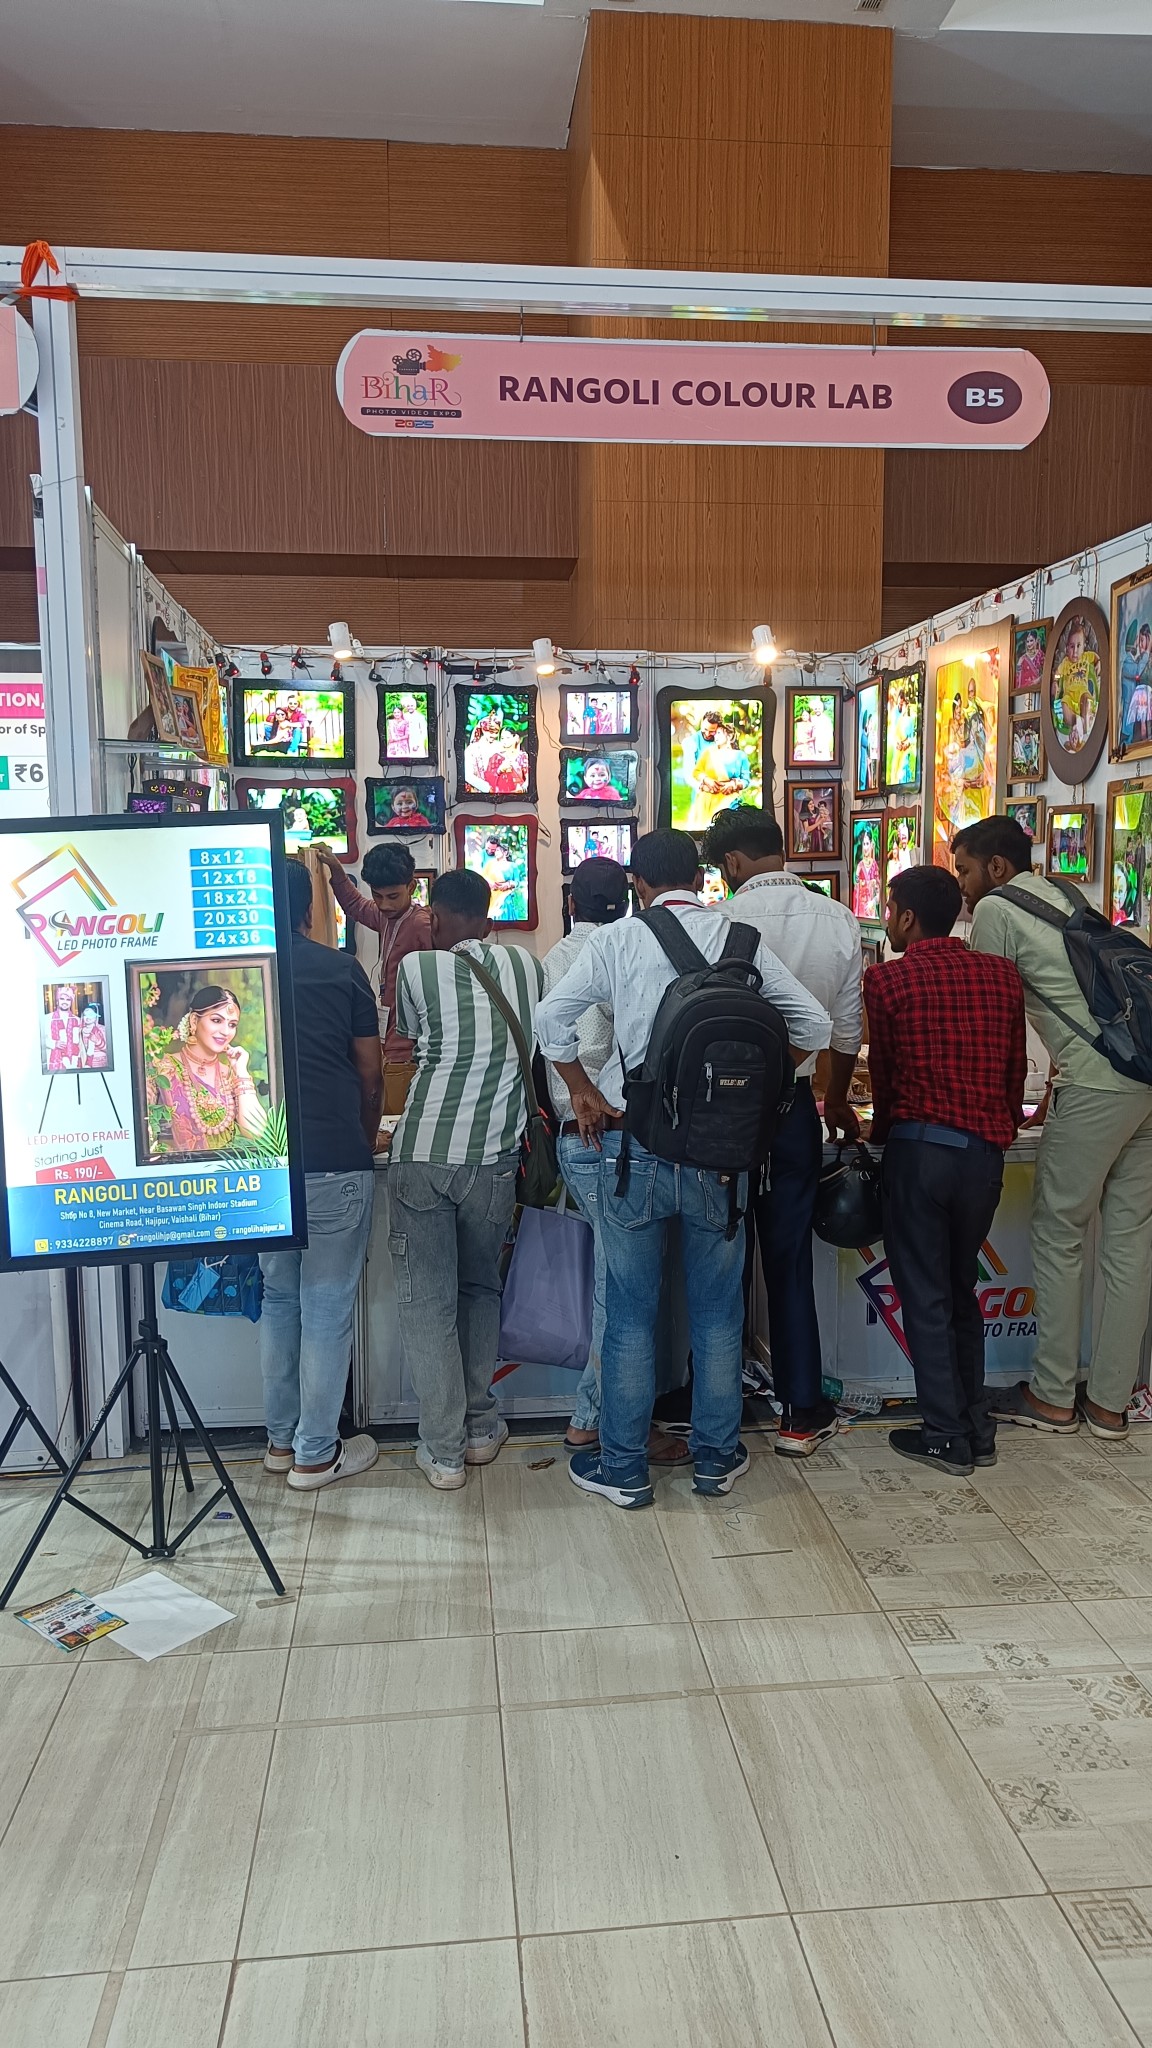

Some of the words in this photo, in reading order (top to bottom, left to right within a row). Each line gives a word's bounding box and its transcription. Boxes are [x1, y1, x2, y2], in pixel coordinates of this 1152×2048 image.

[499, 375, 659, 405] RANGOLI
[671, 380, 817, 408] COLOUR
[828, 383, 893, 409] LAB
[965, 387, 1005, 408] B5
[395, 419, 434, 429] 2025
[14, 724, 27, 734] of
[200, 850, 245, 865] 8x12
[202, 870, 257, 885] 12x18
[203, 890, 259, 905] 18x24
[23, 909, 165, 940] RANGOLI
[204, 910, 259, 926] 20x30
[57, 940, 78, 951] LED
[81, 938, 118, 950] PHOTO
[120, 936, 159, 947] FRAME
[205, 930, 261, 946] 24x36
[27, 1135, 48, 1146] LED
[51, 1132, 90, 1144] PHOTO
[92, 1130, 130, 1142] FRAME
[34, 1151, 78, 1168] Starting
[81, 1144, 104, 1158] Just
[54, 1168, 72, 1180] Rs.
[74, 1165, 103, 1180] 190/-
[54, 1182, 138, 1205] RANGOLI
[143, 1177, 218, 1200] COLOUR
[224, 1174, 262, 1194] LAB
[60, 1210, 78, 1221] Shop
[78, 1211, 88, 1219] No
[96, 1209, 111, 1218] New
[112, 1206, 138, 1217] Market,
[139, 1205, 155, 1214] Near
[156, 1204, 186, 1213] Basawan
[187, 1202, 207, 1212] Singh
[208, 1201, 228, 1210] Indoor
[230, 1198, 258, 1208] Stadium
[99, 1220, 124, 1229] Cinema
[125, 1218, 144, 1228] Road,
[145, 1216, 171, 1228] Hajipur,
[171, 1213, 198, 1223] Vaishali
[198, 1212, 221, 1222] (Bihar)
[55, 1236, 114, 1249] 9334228897
[1006, 1321, 1038, 1338] FRA
